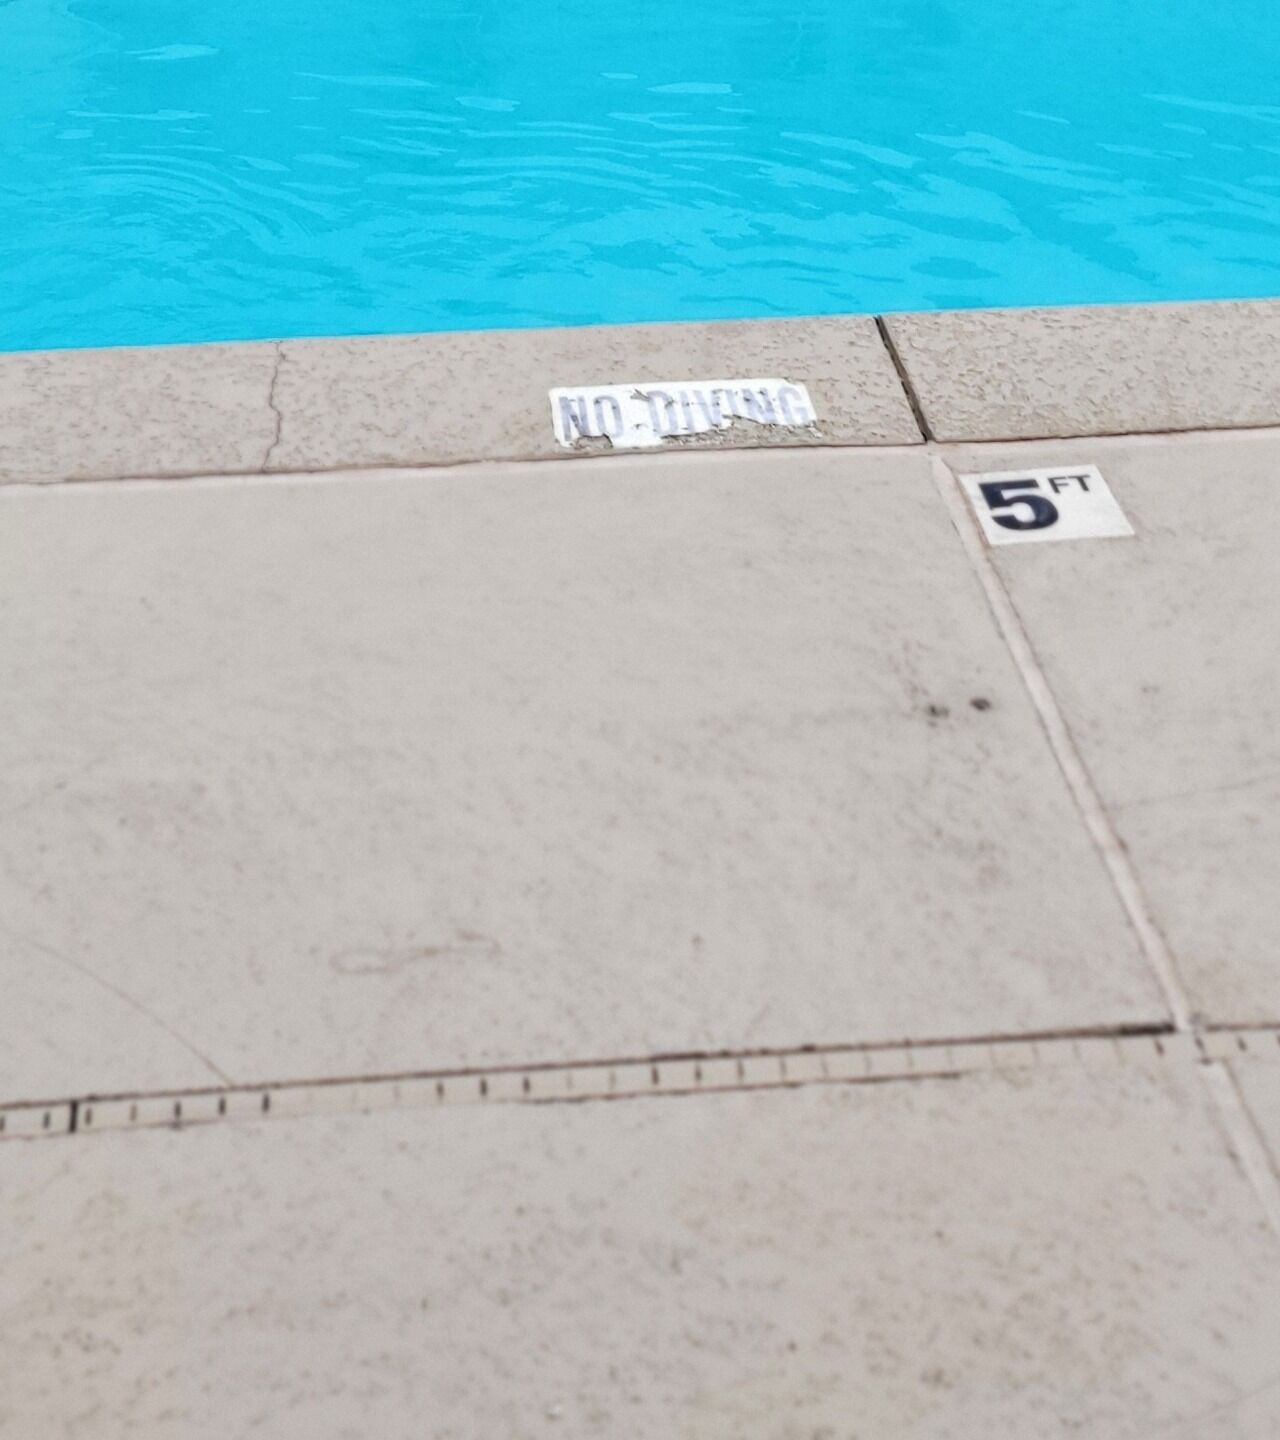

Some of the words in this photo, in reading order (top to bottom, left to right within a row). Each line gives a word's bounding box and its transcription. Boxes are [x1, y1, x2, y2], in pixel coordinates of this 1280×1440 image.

[557, 394, 625, 442] NO
[646, 386, 812, 435] DIVING
[978, 478, 1059, 531] 5
[1047, 474, 1091, 494] FT
